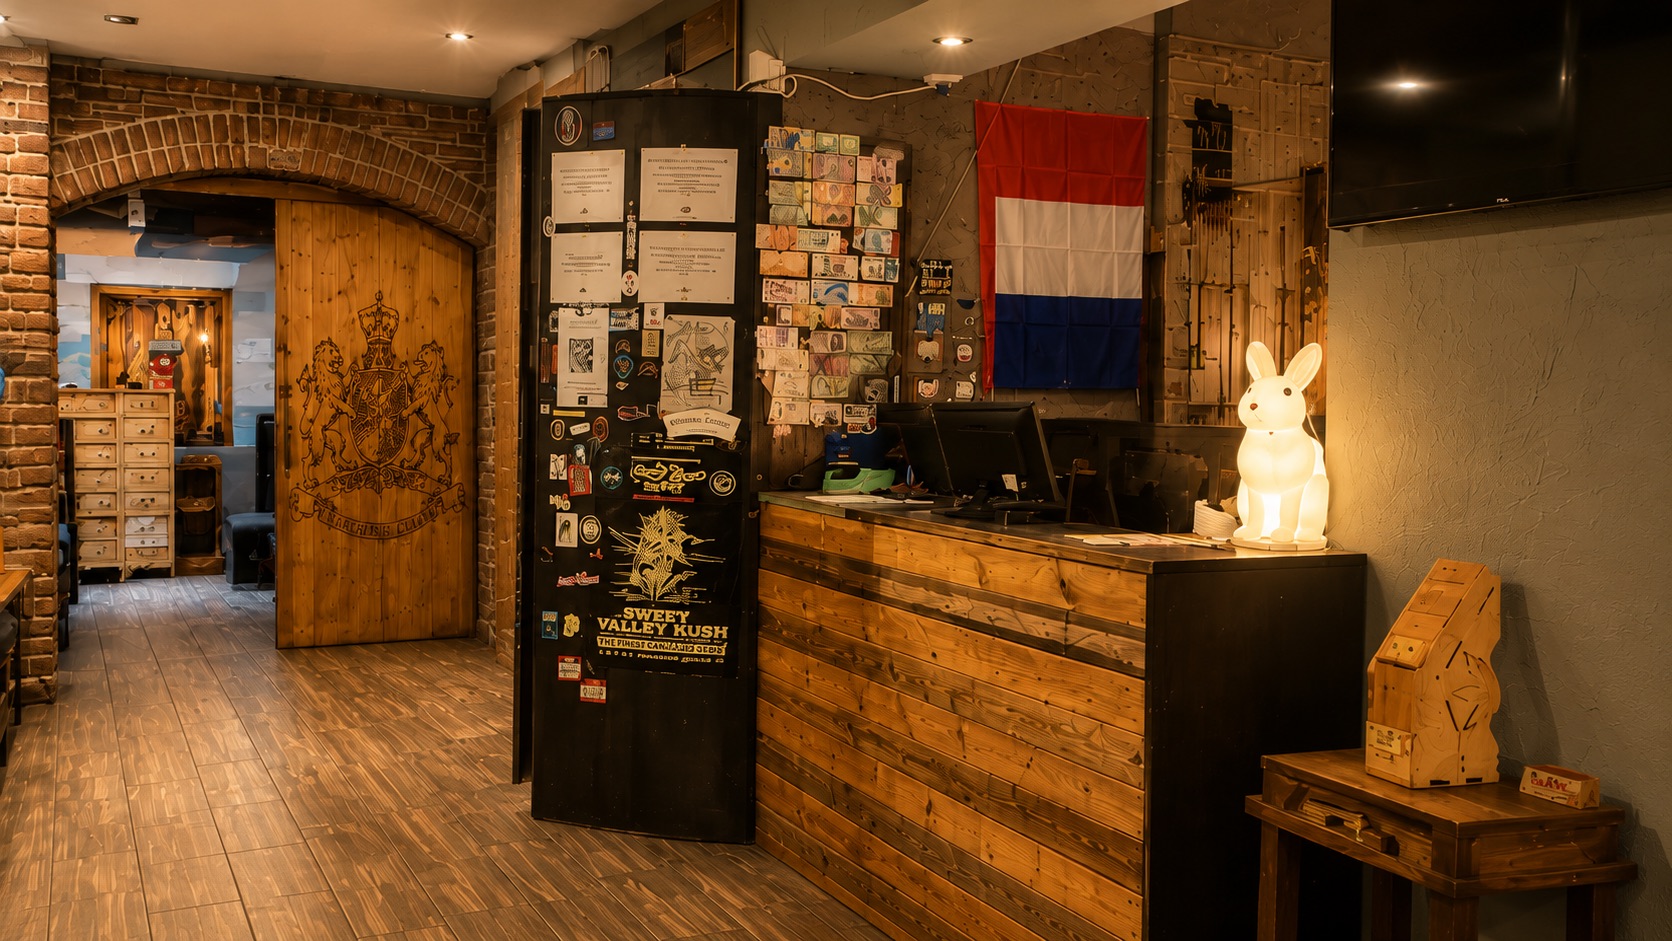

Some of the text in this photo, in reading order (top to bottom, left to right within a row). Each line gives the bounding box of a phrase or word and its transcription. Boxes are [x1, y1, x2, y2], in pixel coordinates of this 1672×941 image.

[597, 617, 729, 639] VALLEY KUSH
[598, 637, 616, 647] THE
